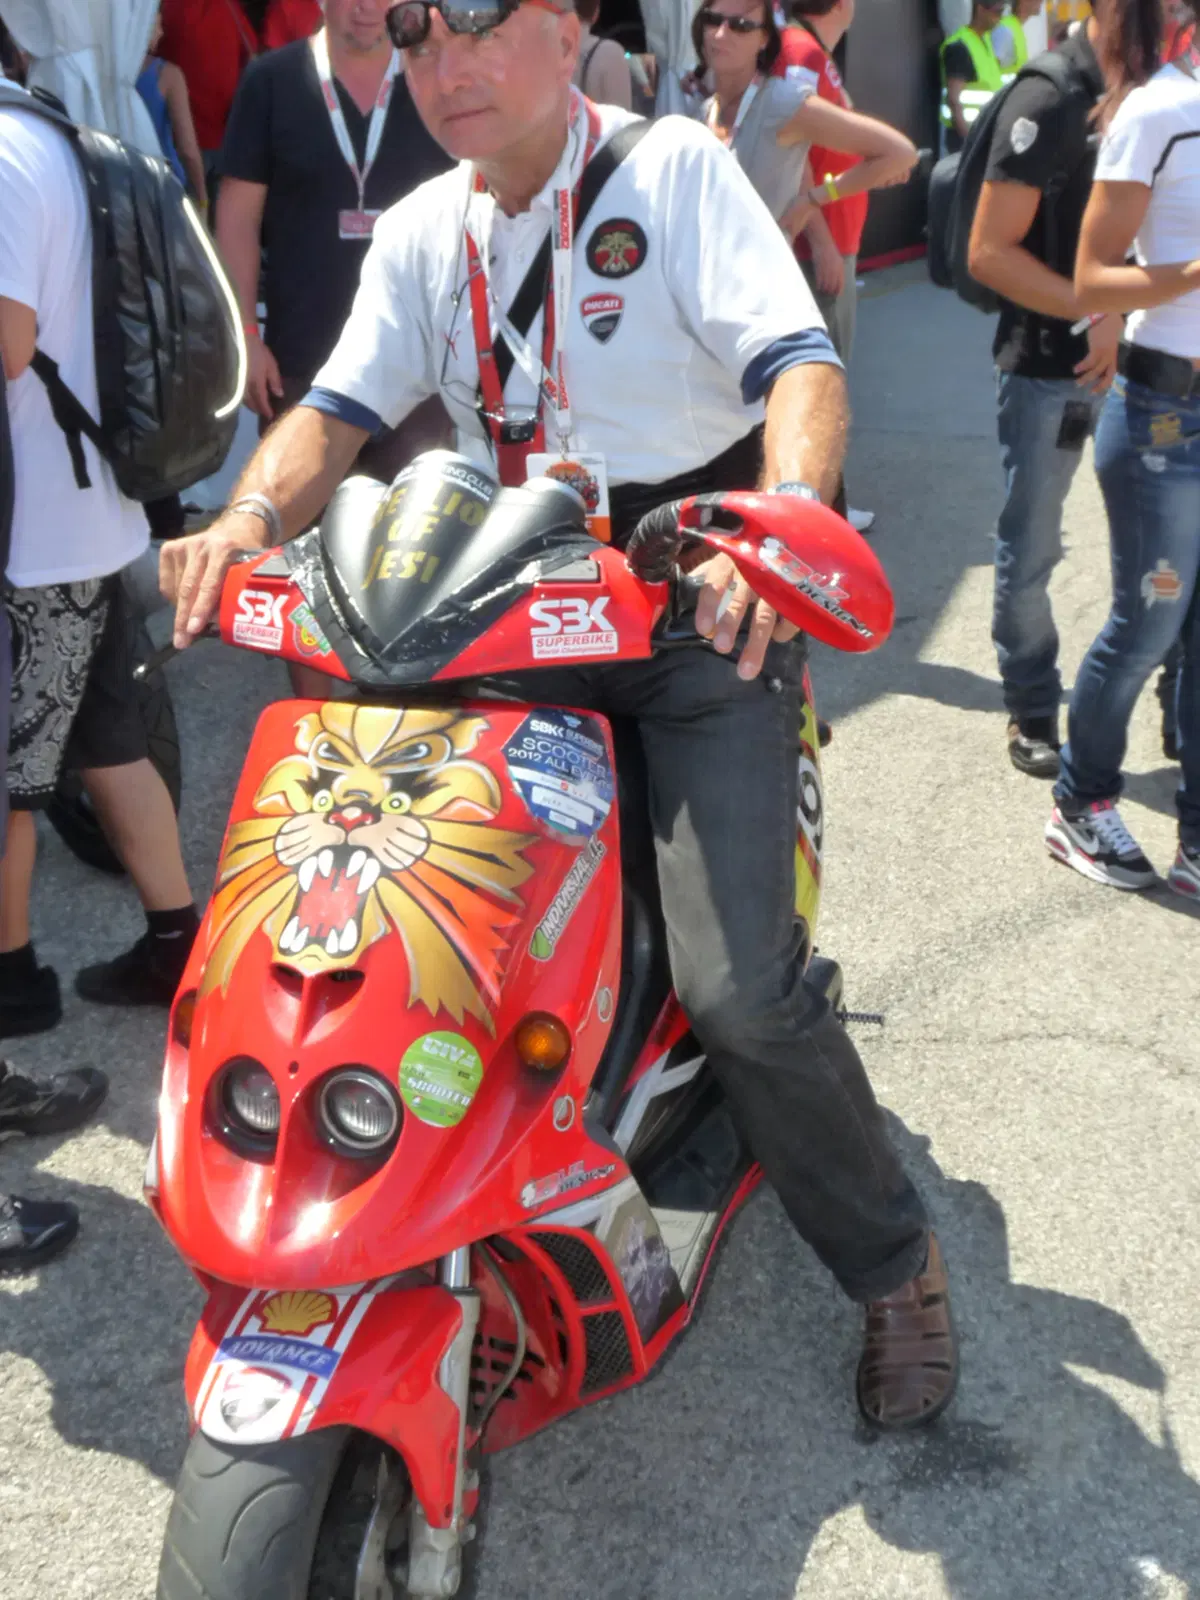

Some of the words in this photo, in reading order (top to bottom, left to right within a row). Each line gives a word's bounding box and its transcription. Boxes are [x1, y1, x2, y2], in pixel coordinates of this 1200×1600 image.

[584, 299, 620, 311] DUCATI
[234, 590, 290, 630] SBK
[529, 596, 616, 636] SBK
[536, 633, 614, 648] SUPERBIKE
[508, 748, 542, 763] 2012
[545, 756, 570, 773] ALL
[523, 737, 607, 778] SCOOTER
[229, 1340, 333, 1367] ADVANCE
